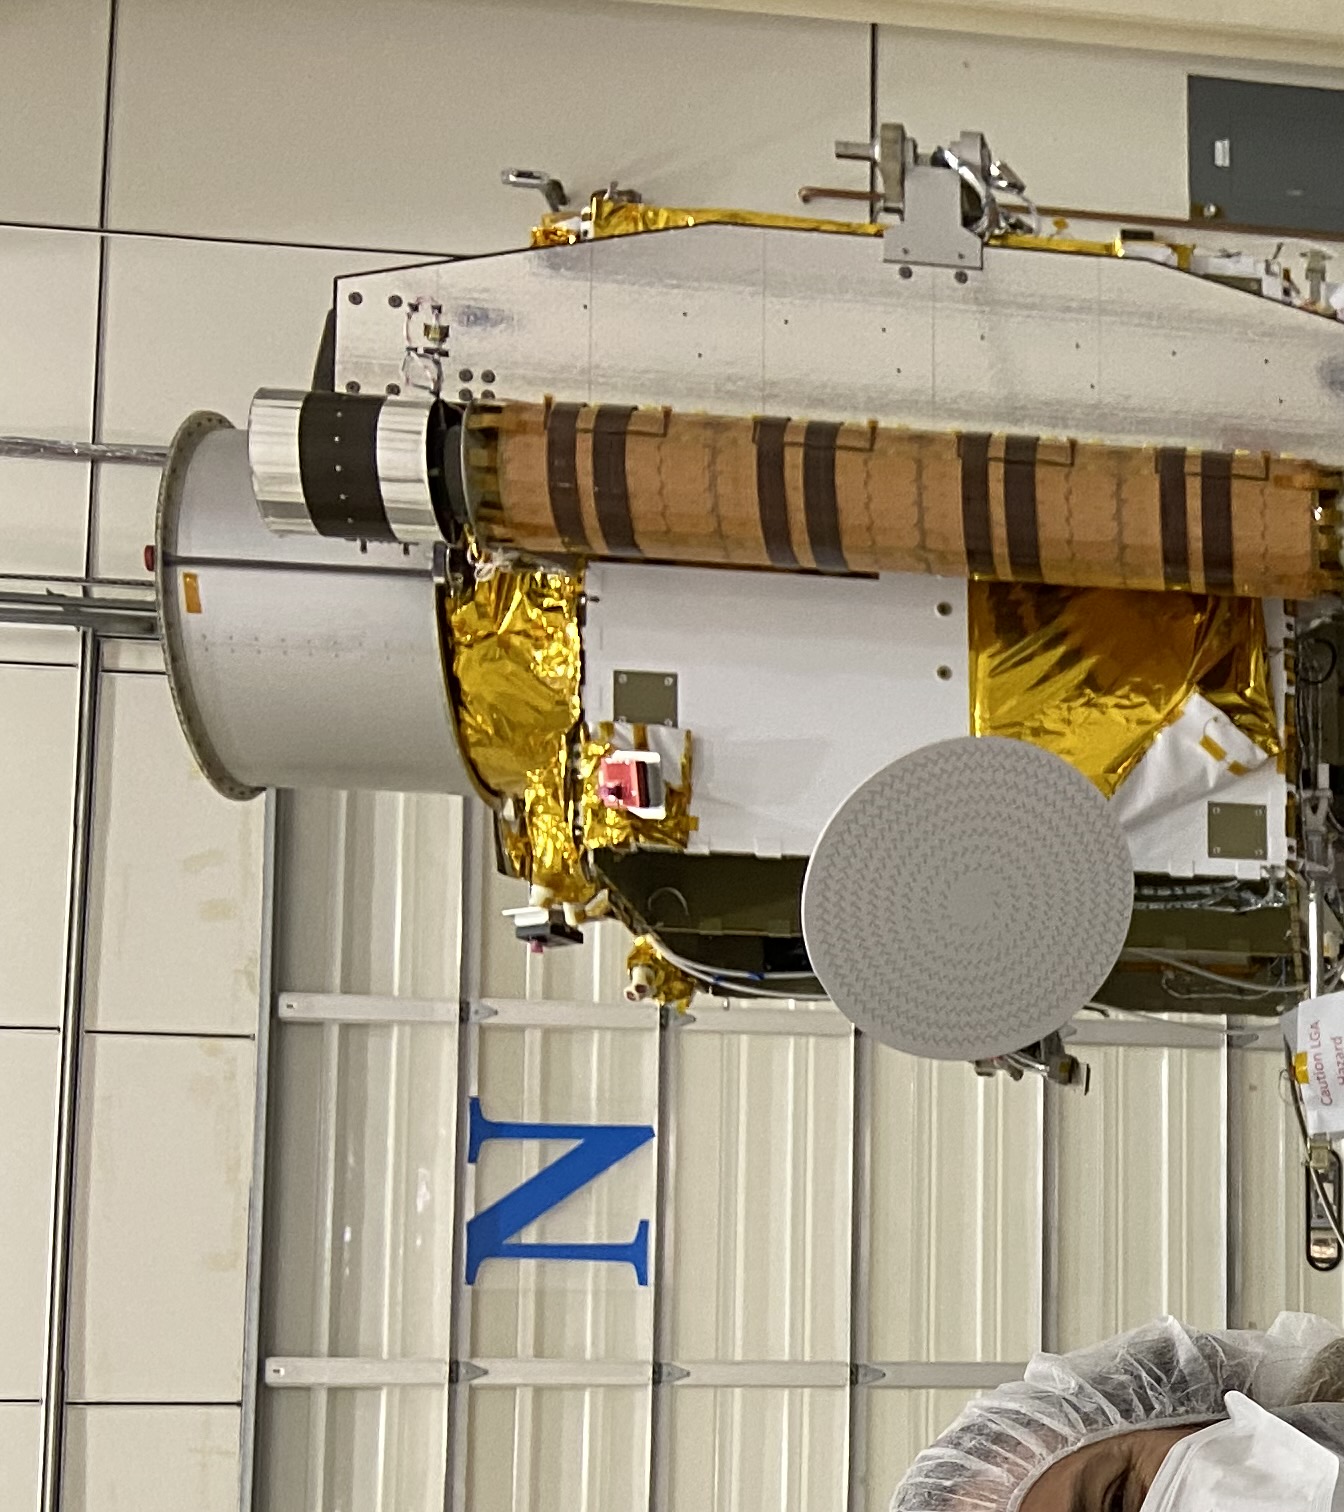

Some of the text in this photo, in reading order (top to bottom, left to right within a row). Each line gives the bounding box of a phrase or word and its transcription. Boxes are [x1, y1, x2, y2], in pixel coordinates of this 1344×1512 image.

[1309, 1020, 1333, 1106] Caution LGA
[464, 1097, 656, 1286] N
